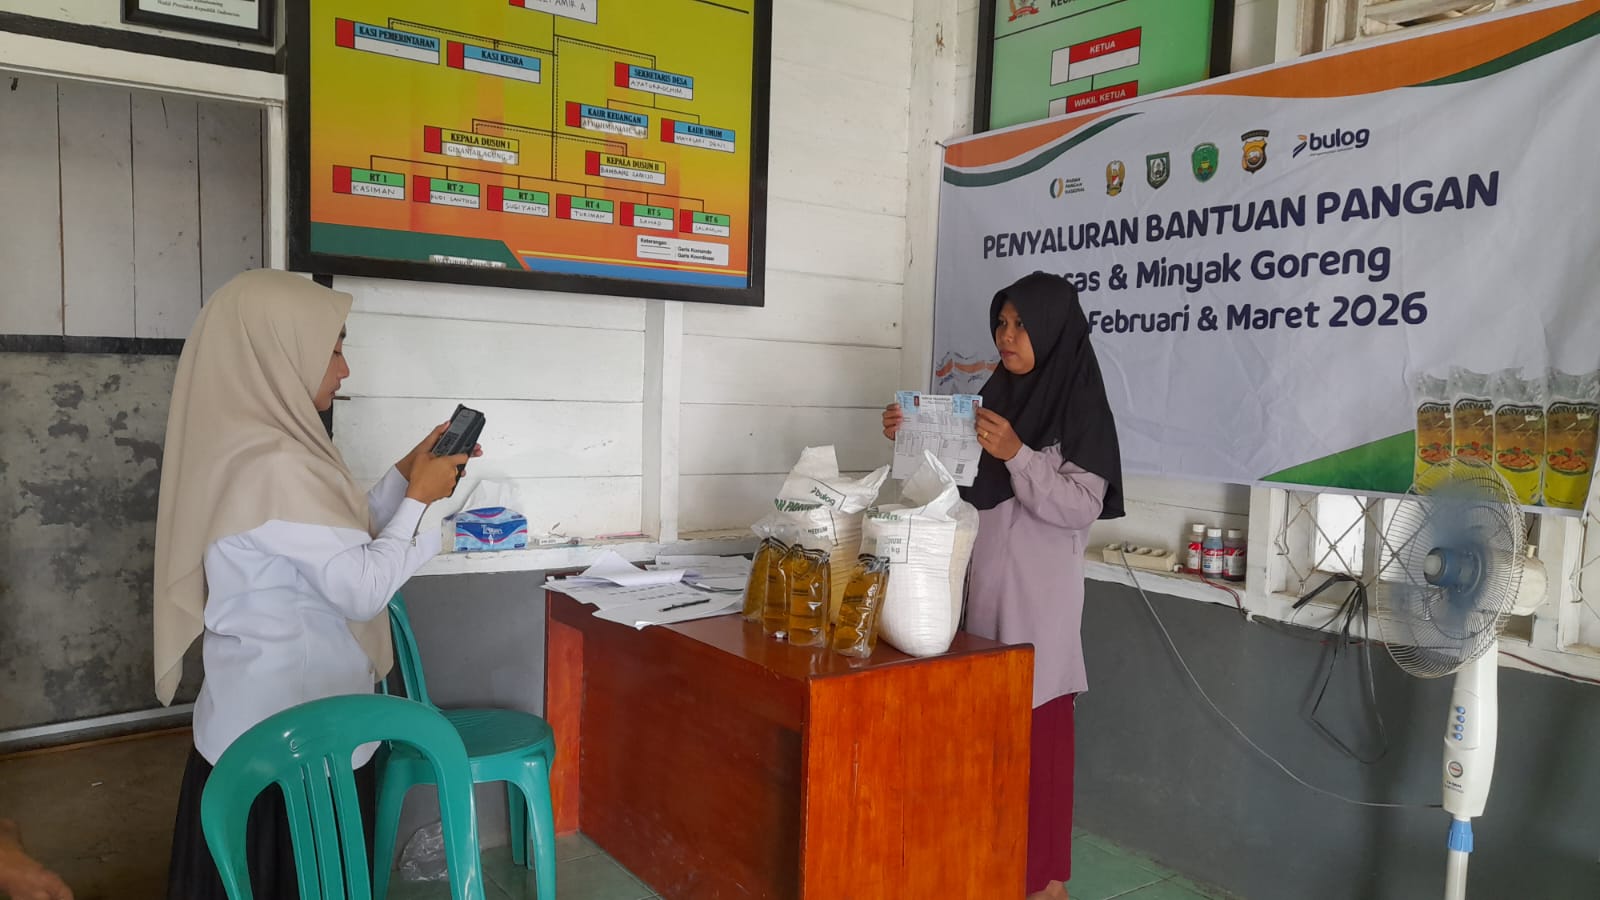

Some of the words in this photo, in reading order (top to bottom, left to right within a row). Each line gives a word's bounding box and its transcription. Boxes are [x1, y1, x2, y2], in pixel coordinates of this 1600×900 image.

[359, 26, 377, 37] KASI
[379, 29, 435, 49] PEMERINTAHAN
[1089, 40, 1116, 54] KETUA
[482, 50, 499, 61] KASI
[500, 54, 524, 66] KESRA
[634, 69, 671, 82] SEKRETARIS
[672, 76, 688, 86] DESA
[1074, 94, 1098, 108] WAKIL
[1099, 89, 1126, 102] KETUA
[588, 108, 605, 118] KAUR
[607, 110, 642, 123] KEUANGAN
[688, 125, 704, 134] KAUR
[705, 128, 722, 138] UMUM
[451, 133, 480, 144] KEPALA
[481, 137, 506, 148] DUSUN
[1309, 128, 1370, 151] bulog
[607, 156, 631, 167] KEPALA
[633, 160, 653, 170] DUSUN
[369, 173, 382, 182] RT
[353, 183, 395, 196] KASIMAN
[447, 183, 457, 192] RT
[519, 192, 529, 200] RT
[586, 200, 594, 209] RT
[647, 208, 657, 216] RT
[983, 217, 1139, 259] PENYALURAN
[1145, 195, 1306, 243] BANTUAN
[1316, 170, 1500, 224] PANGAN
[1108, 264, 1128, 291] &
[1136, 252, 1242, 293] Minyak
[1250, 246, 1391, 283] Goreng
[1089, 304, 1190, 334] Februari
[1197, 306, 1218, 332] &
[1226, 301, 1320, 331] Maret
[1329, 291, 1428, 328] 2026
